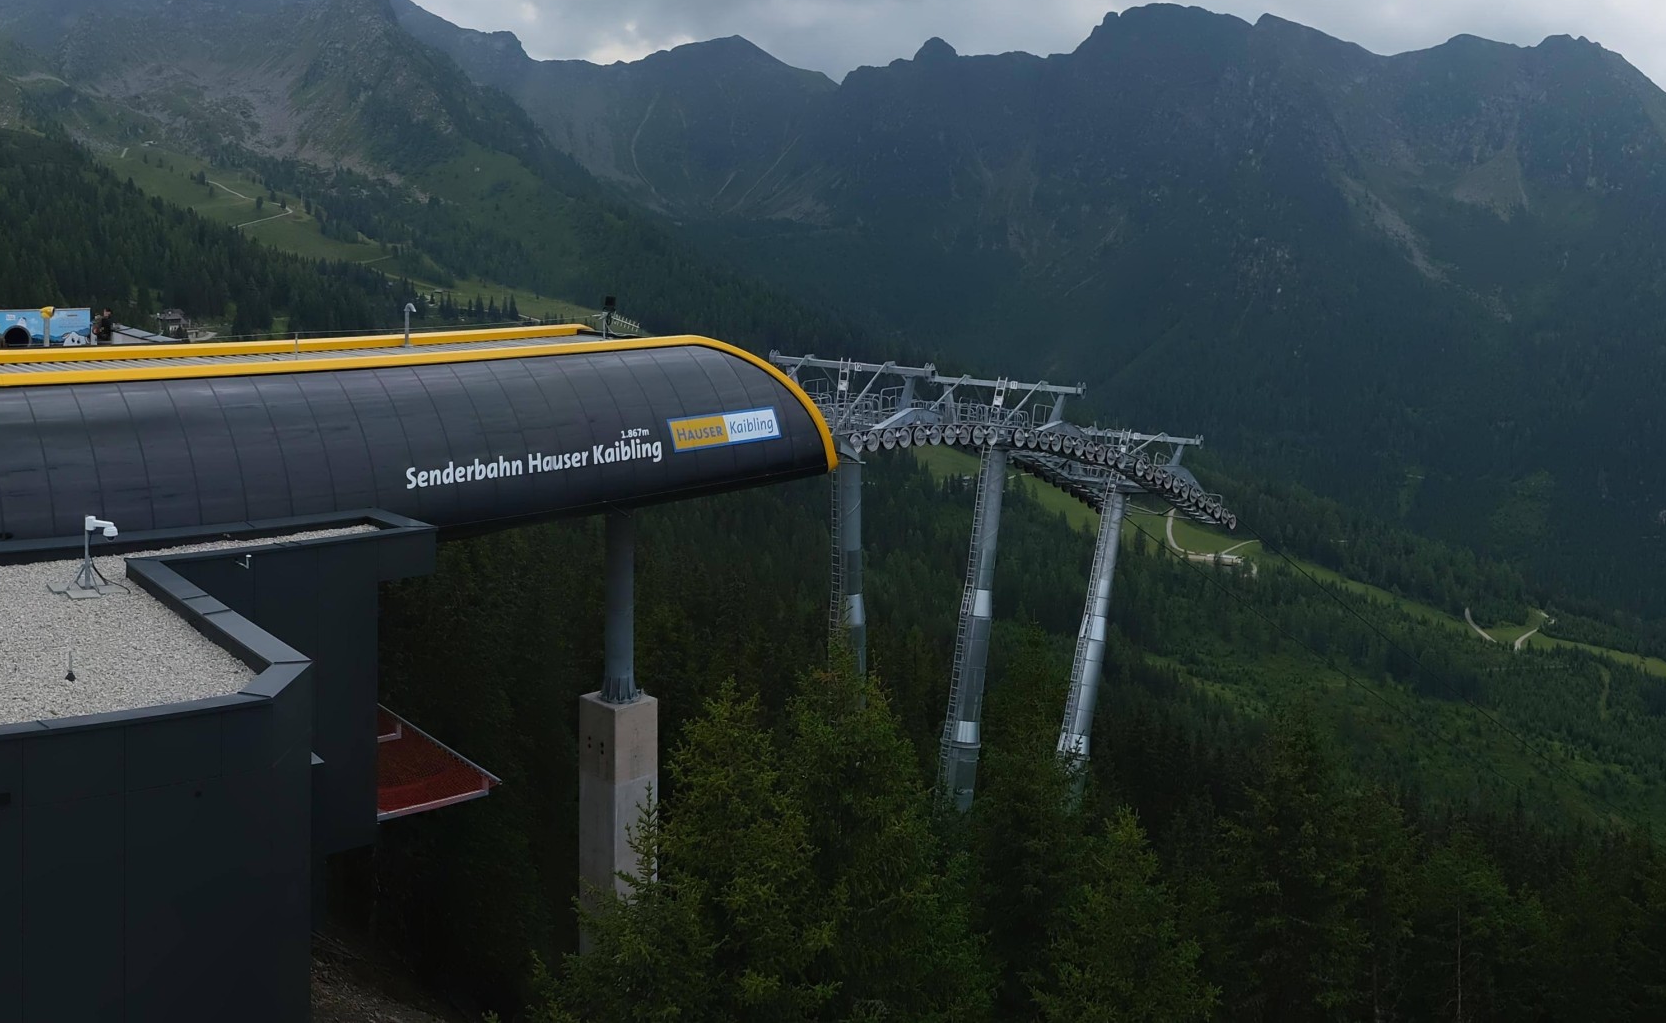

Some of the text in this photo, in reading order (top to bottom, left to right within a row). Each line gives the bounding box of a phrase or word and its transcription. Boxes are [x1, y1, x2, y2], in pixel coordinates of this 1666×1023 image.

[621, 428, 649, 439] 1.867m
[676, 418, 773, 442] HAUSER Kaibling
[406, 438, 662, 489] Senderbahn Hauser Kaibling
